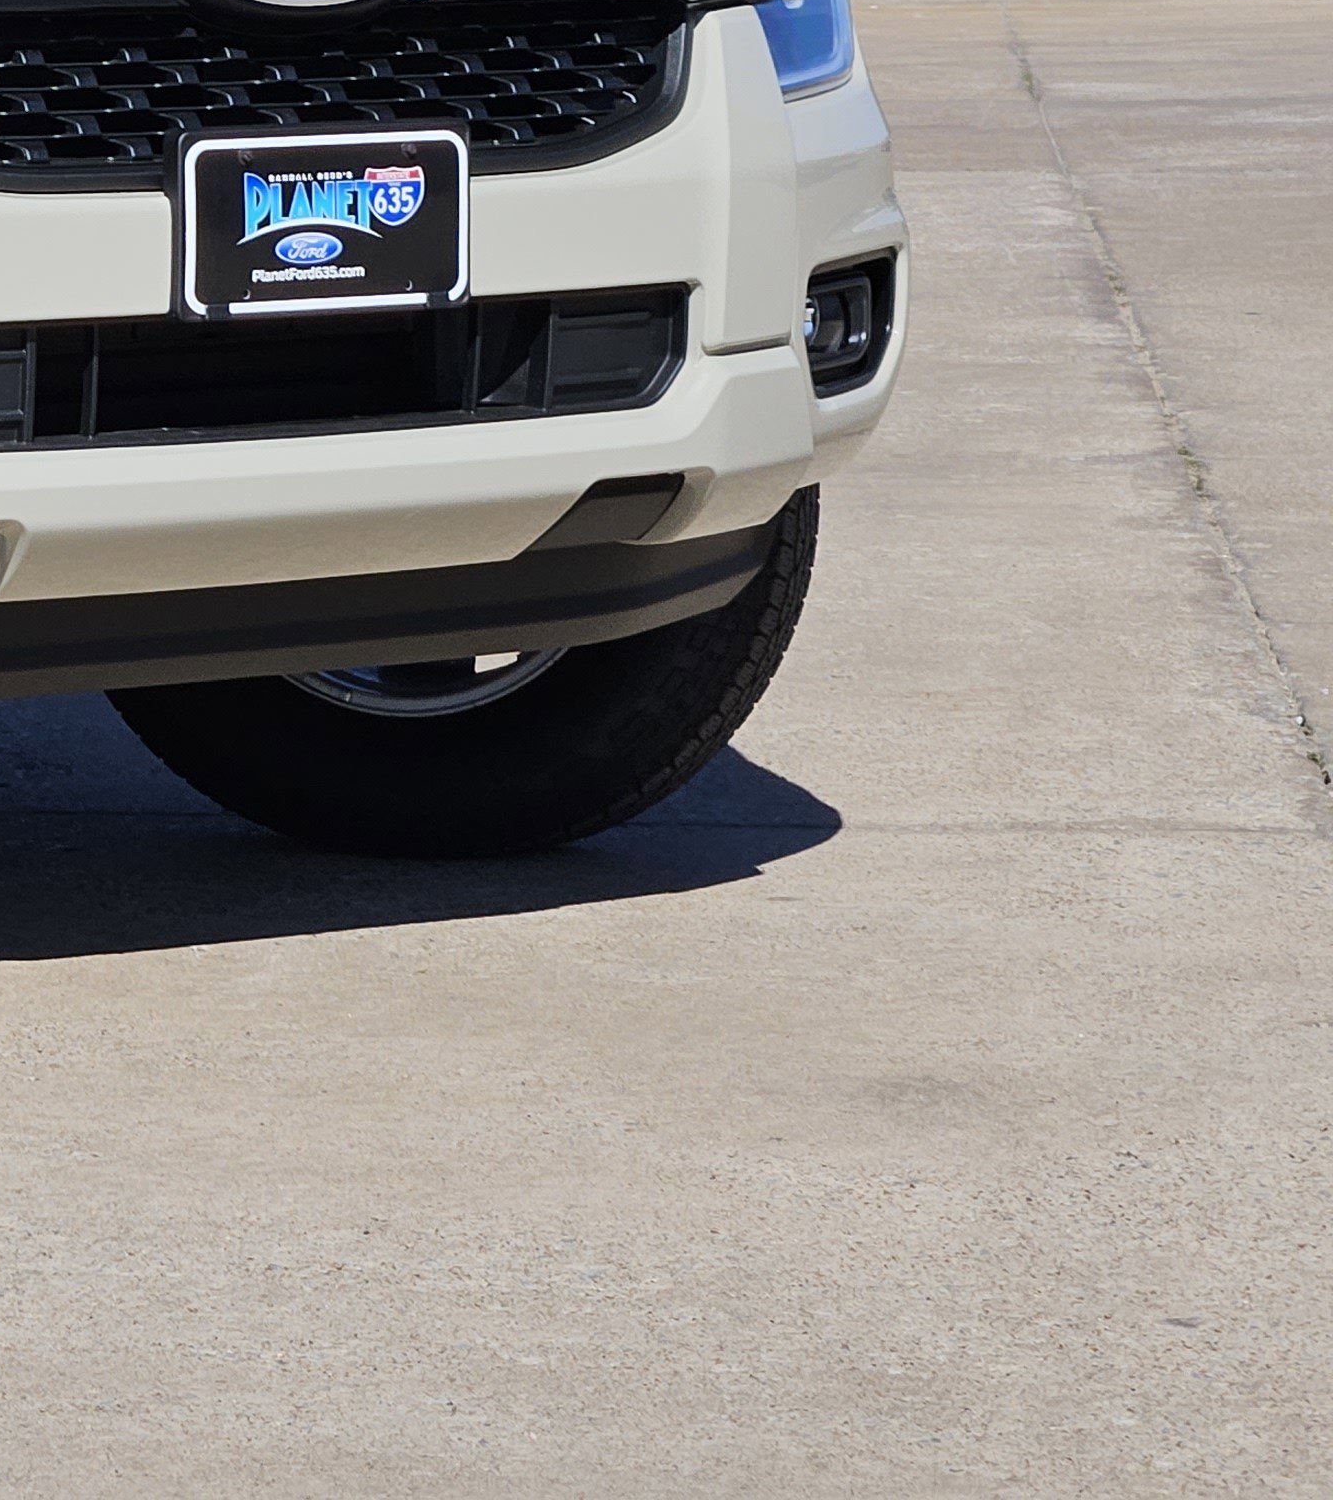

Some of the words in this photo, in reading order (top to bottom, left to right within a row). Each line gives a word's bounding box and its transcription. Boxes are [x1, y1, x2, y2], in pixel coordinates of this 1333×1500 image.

[244, 172, 373, 239] PLANET
[374, 185, 415, 215] 635
[287, 236, 330, 260] Ford
[251, 264, 366, 284] PlanetFord635.com
